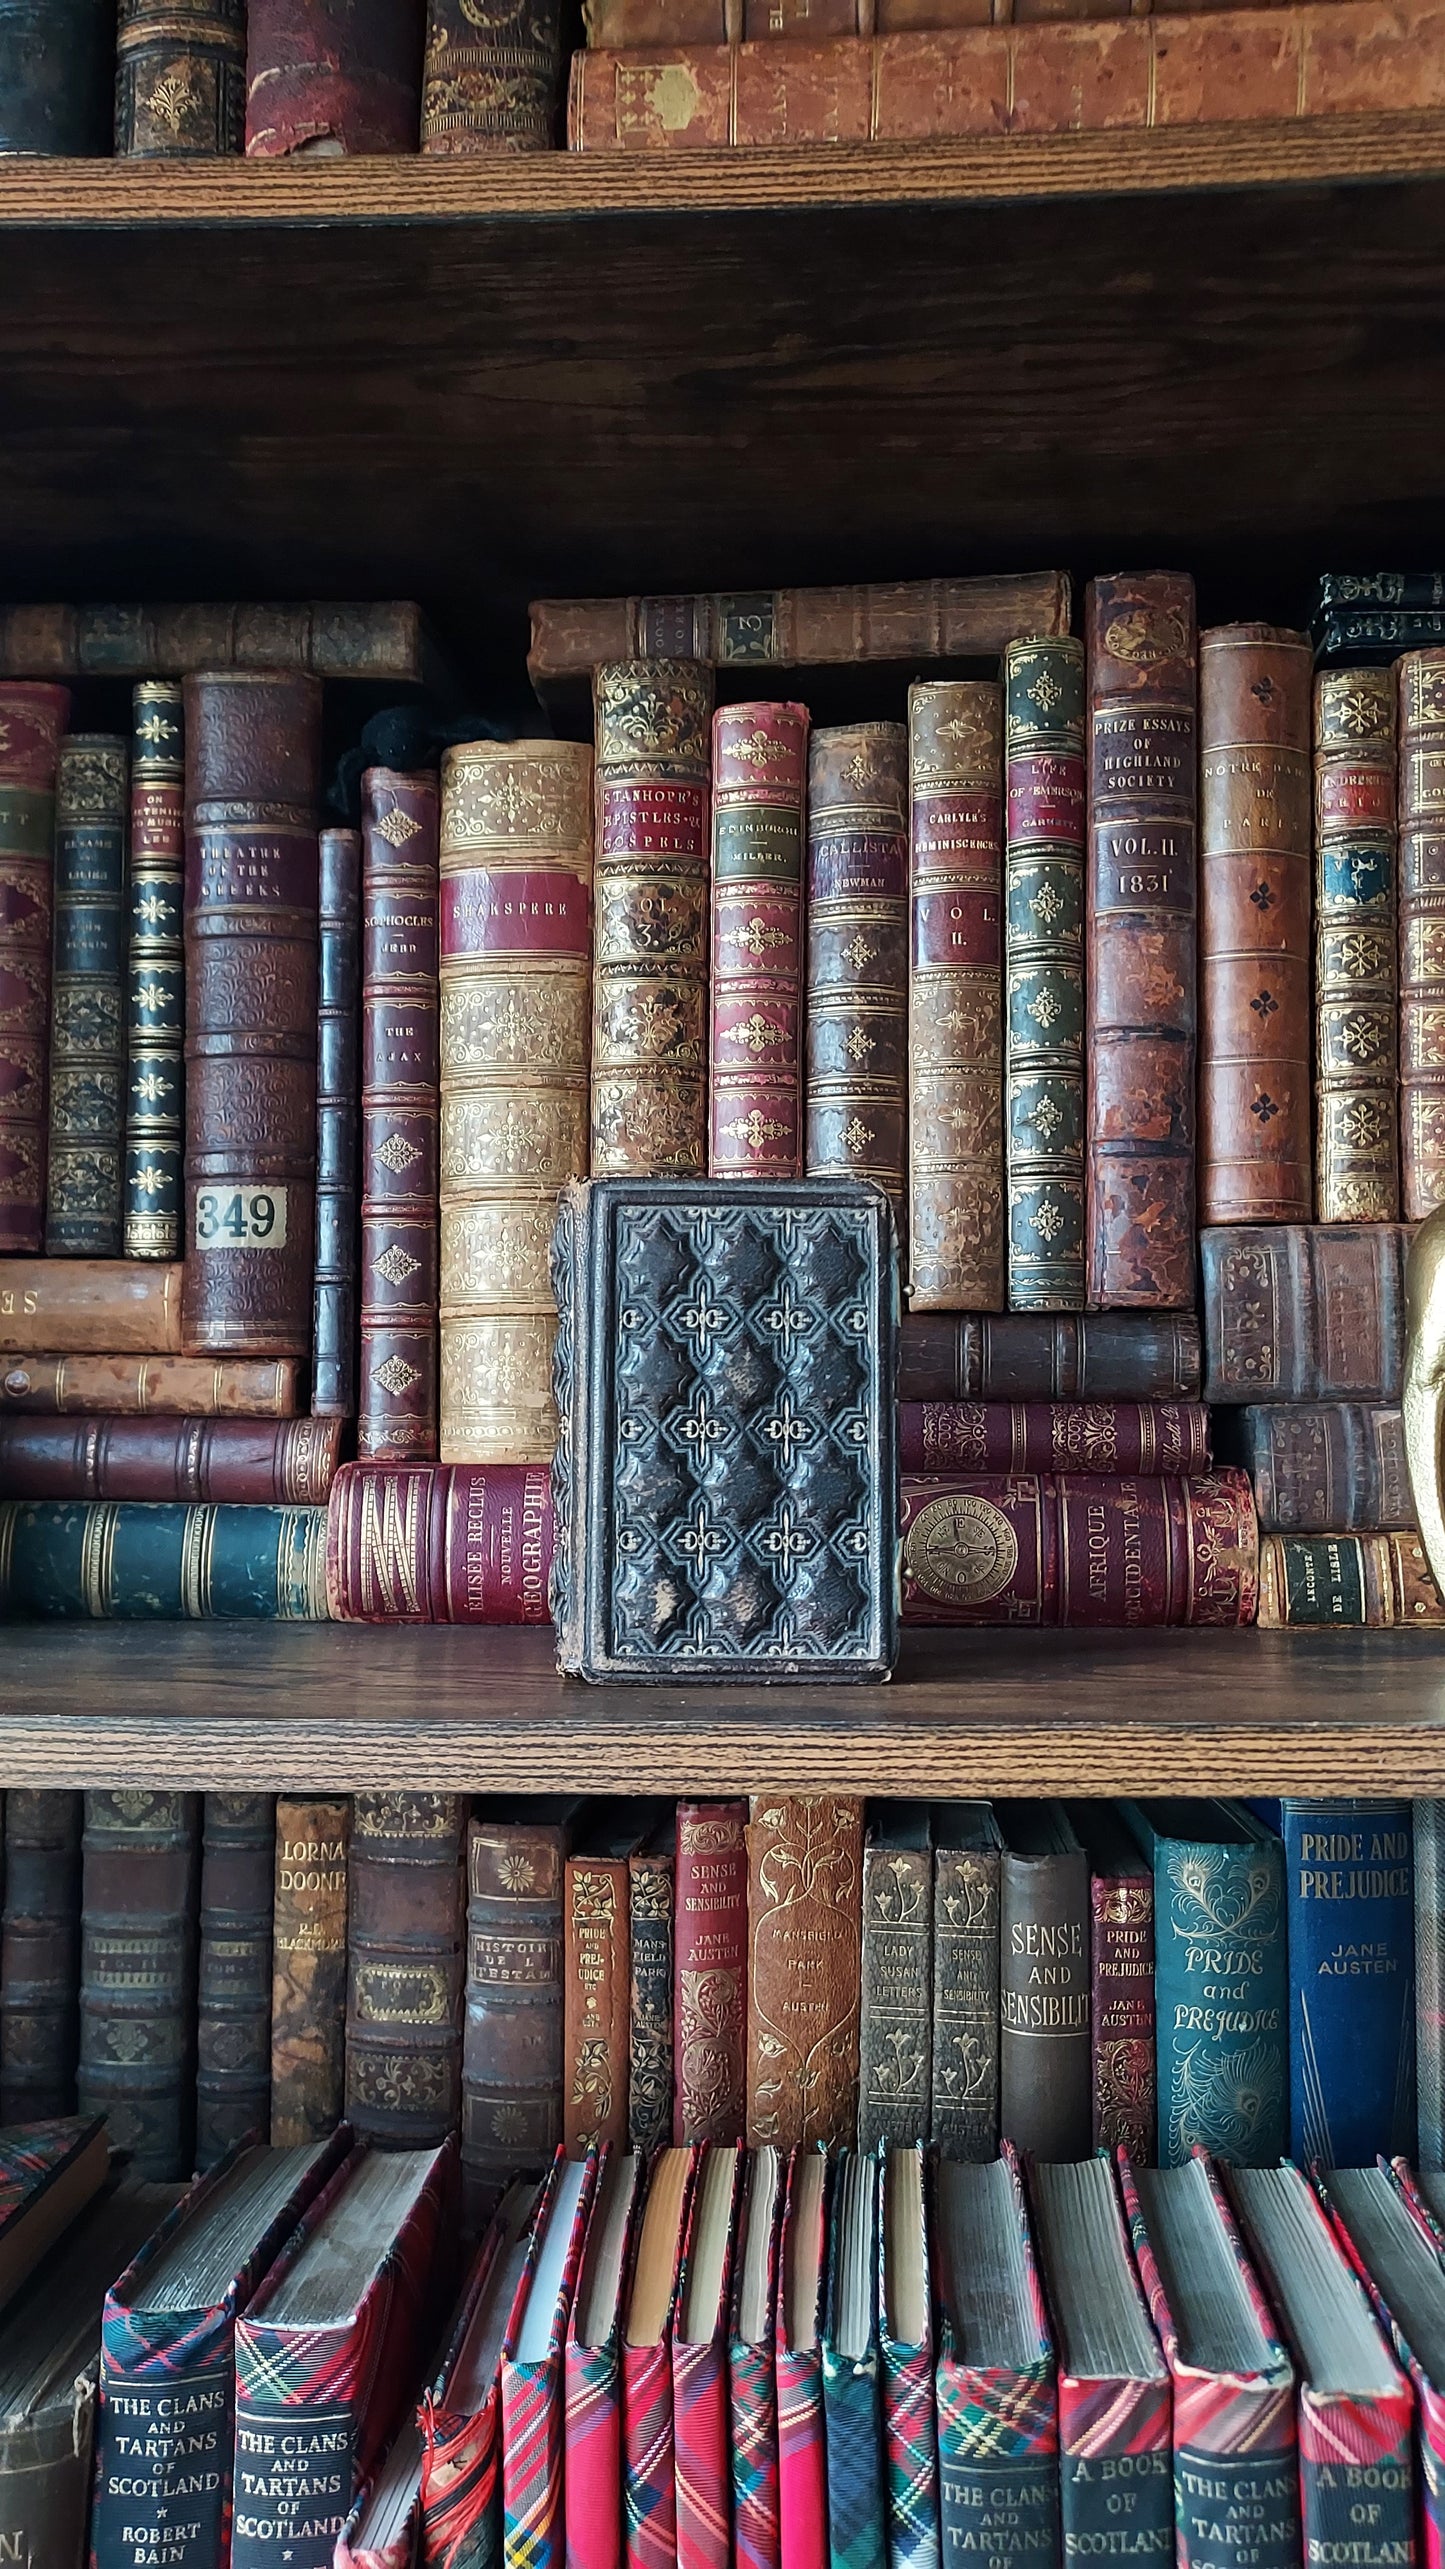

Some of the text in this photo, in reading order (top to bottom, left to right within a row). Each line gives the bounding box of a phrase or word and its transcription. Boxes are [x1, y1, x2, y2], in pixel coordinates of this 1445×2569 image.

[738, 615, 762, 632] 3
[1096, 718, 1191, 735] PRIZE ESSAYS
[1133, 737, 1151, 750] OF
[1031, 764, 1067, 776] LIFE
[1104, 756, 1181, 770] HIGHLAND
[1108, 775, 1175, 789] SOCIETY
[147, 795, 163, 804] ON
[604, 790, 699, 805] STANHOPE'S
[1010, 787, 1024, 799] OF
[1256, 789, 1274, 799] DE
[929, 809, 987, 824] CARLYLE'S
[718, 823, 799, 837] EDINBURGH
[143, 835, 171, 844] LEE
[603, 834, 694, 850] GOSPELS
[915, 838, 999, 852] REMINISCENCES
[200, 847, 281, 859] THEATRE
[820, 841, 899, 857] CALLISTA
[208, 864, 269, 877] OF THE
[201, 883, 280, 897] GREEKS
[834, 878, 886, 889] NEWMAN
[1118, 875, 1168, 894] 1831
[453, 902, 568, 918] SHAKSPERE
[364, 916, 433, 928] SOPHOCLES
[951, 931, 968, 946] II.
[385, 1027, 414, 1037] THE
[375, 1053, 422, 1063] AJAX
[198, 1194, 275, 1238] 349
[462, 1477, 486, 1612] ÉLISÉE RECLUS
[501, 1506, 513, 1585] NOUVELLE
[518, 1472, 545, 1618] GÉOGRAPHIE
[1087, 1505, 1111, 1602] AFRIQUE
[1327, 1543, 1343, 1613] DE LISLE
[282, 1841, 346, 1862] LORNA
[1301, 1832, 1409, 1862] PRIDE AND
[691, 1863, 737, 1880] SENSE
[700, 1882, 727, 1894] AND
[1299, 1868, 1409, 1899] PREJUDICE
[685, 1894, 741, 1912] SENSIBILITY
[578, 1928, 607, 1940] PRIDE
[695, 1932, 730, 1946] JANE
[772, 1929, 842, 1942] MANSFIELD
[1011, 1922, 1082, 1958] SENSE
[1107, 1930, 1147, 1944] PRIDE
[276, 1937, 345, 1950] BLACKMORE
[585, 1942, 599, 1950] AND
[884, 1945, 915, 1957] LADY
[1331, 1942, 1389, 1958] JANE
[485, 1955, 506, 1966] DE
[633, 1952, 667, 1963] FIELD
[687, 1945, 738, 1962] AUSTEN
[952, 1949, 982, 1961] SENSE
[1114, 1948, 1140, 1959] AND
[1184, 1946, 1264, 1975] PRIDE
[635, 1966, 665, 1977] PARK
[788, 1959, 825, 1970] PARK
[880, 1966, 919, 1978] SUSAN
[1099, 1962, 1154, 1977] PREJUDICE
[1318, 1959, 1398, 1975] AUSTEN
[578, 1969, 605, 1982] UDICE
[957, 1970, 978, 1982] AND
[1028, 1966, 1072, 1984] AND
[876, 1987, 923, 1999] LETTERS
[943, 1989, 990, 2001] SENSIBILITY
[1203, 1981, 1250, 2000] and
[782, 2001, 829, 2013] AUSTEN
[1108, 2000, 1145, 2011] JANE
[1102, 2014, 1152, 2027] AUSTEN
[1173, 2004, 1280, 2042] PREJUDICE
[110, 2391, 225, 2416] THE CLANS
[147, 2421, 186, 2435] AND
[115, 2431, 218, 2458] TARTANS
[238, 2429, 349, 2454] THE CLANS
[152, 2461, 176, 2475] OF
[271, 2458, 309, 2472] AND
[1071, 2451, 1169, 2482] A BOOK
[108, 2472, 220, 2497] SCOTLAND
[241, 2471, 341, 2497] TARTANS
[1182, 2470, 1228, 2500] THE
[1316, 2467, 1337, 2489] A
[942, 2481, 984, 2507] THE
[277, 2501, 301, 2515] OF
[1106, 2492, 1137, 2514] OF
[980, 2511, 1019, 2526] AND
[1225, 2504, 1265, 2519] AND
[1350, 2503, 1381, 2526] OF
[122, 2522, 201, 2544] ROBERT
[236, 2514, 345, 2540] SCOTLAND
[1191, 2517, 1295, 2545] TARTANS
[947, 2527, 1050, 2551] TARTANS
[133, 2545, 187, 2565] BAIN
[988, 2555, 1014, 2569] OF
[1236, 2547, 1259, 2564] OF
